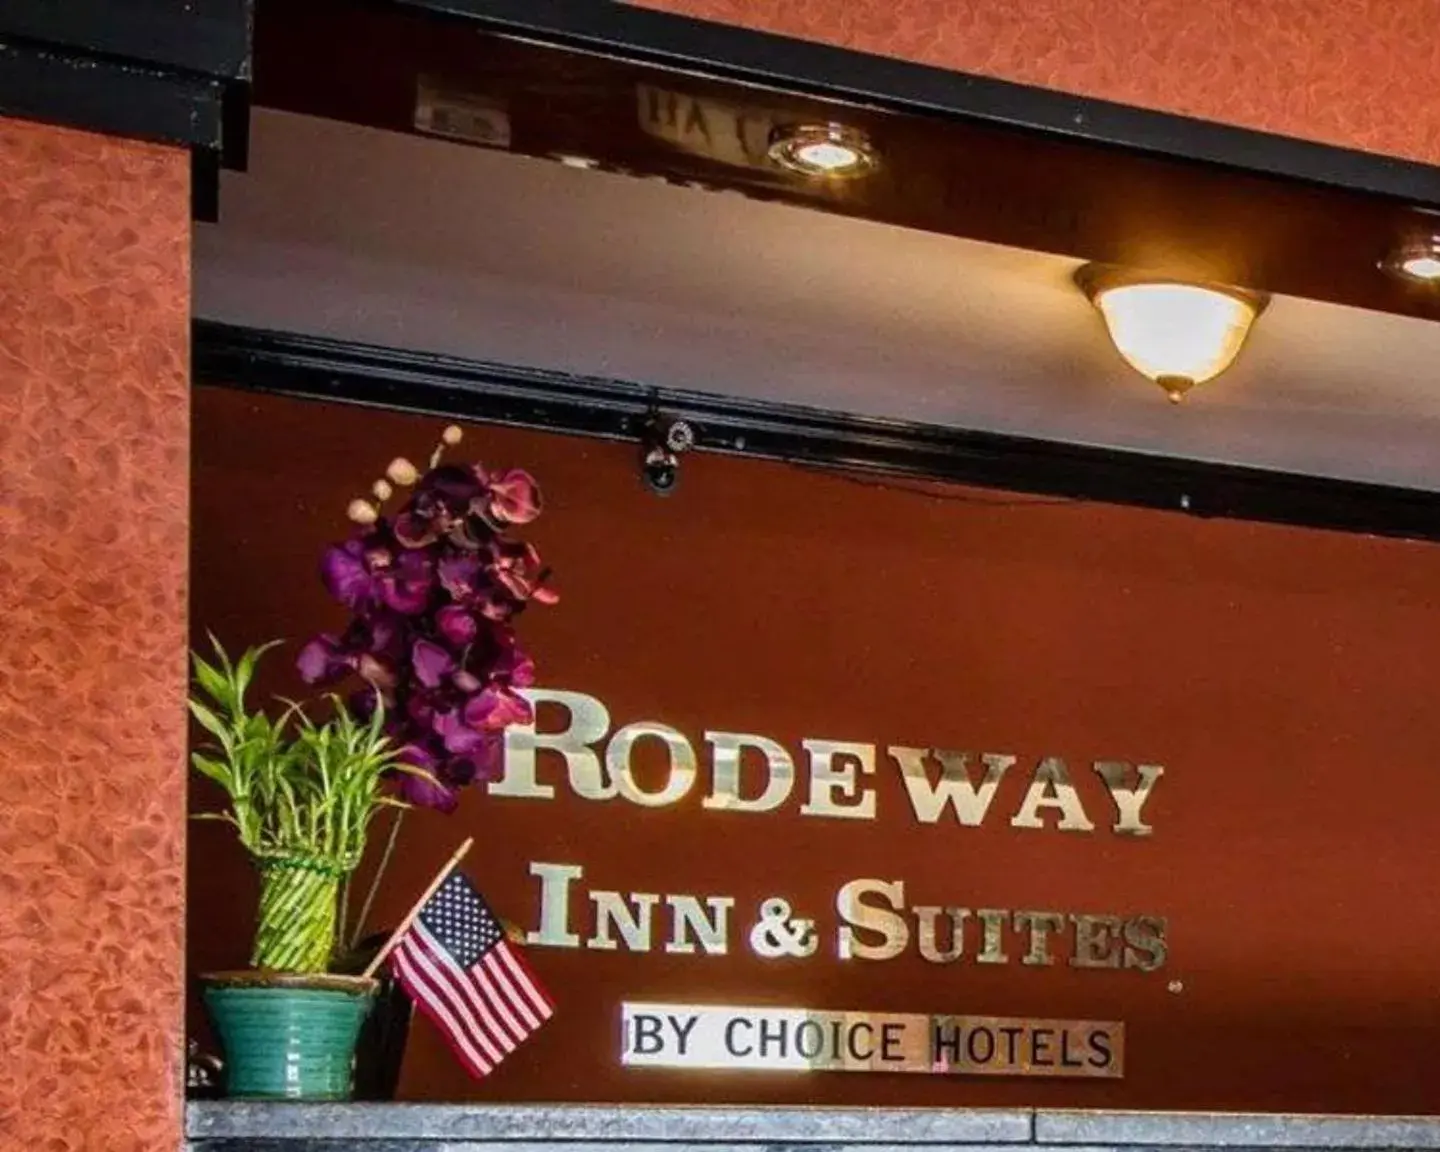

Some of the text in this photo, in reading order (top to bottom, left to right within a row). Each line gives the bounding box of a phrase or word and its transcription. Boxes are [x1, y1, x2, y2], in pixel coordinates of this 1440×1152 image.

[487, 687, 1165, 837] RODEWAY
[525, 861, 1168, 973] INN & SUITES
[631, 1013, 1113, 1068] BY CHOICE HOTELS
